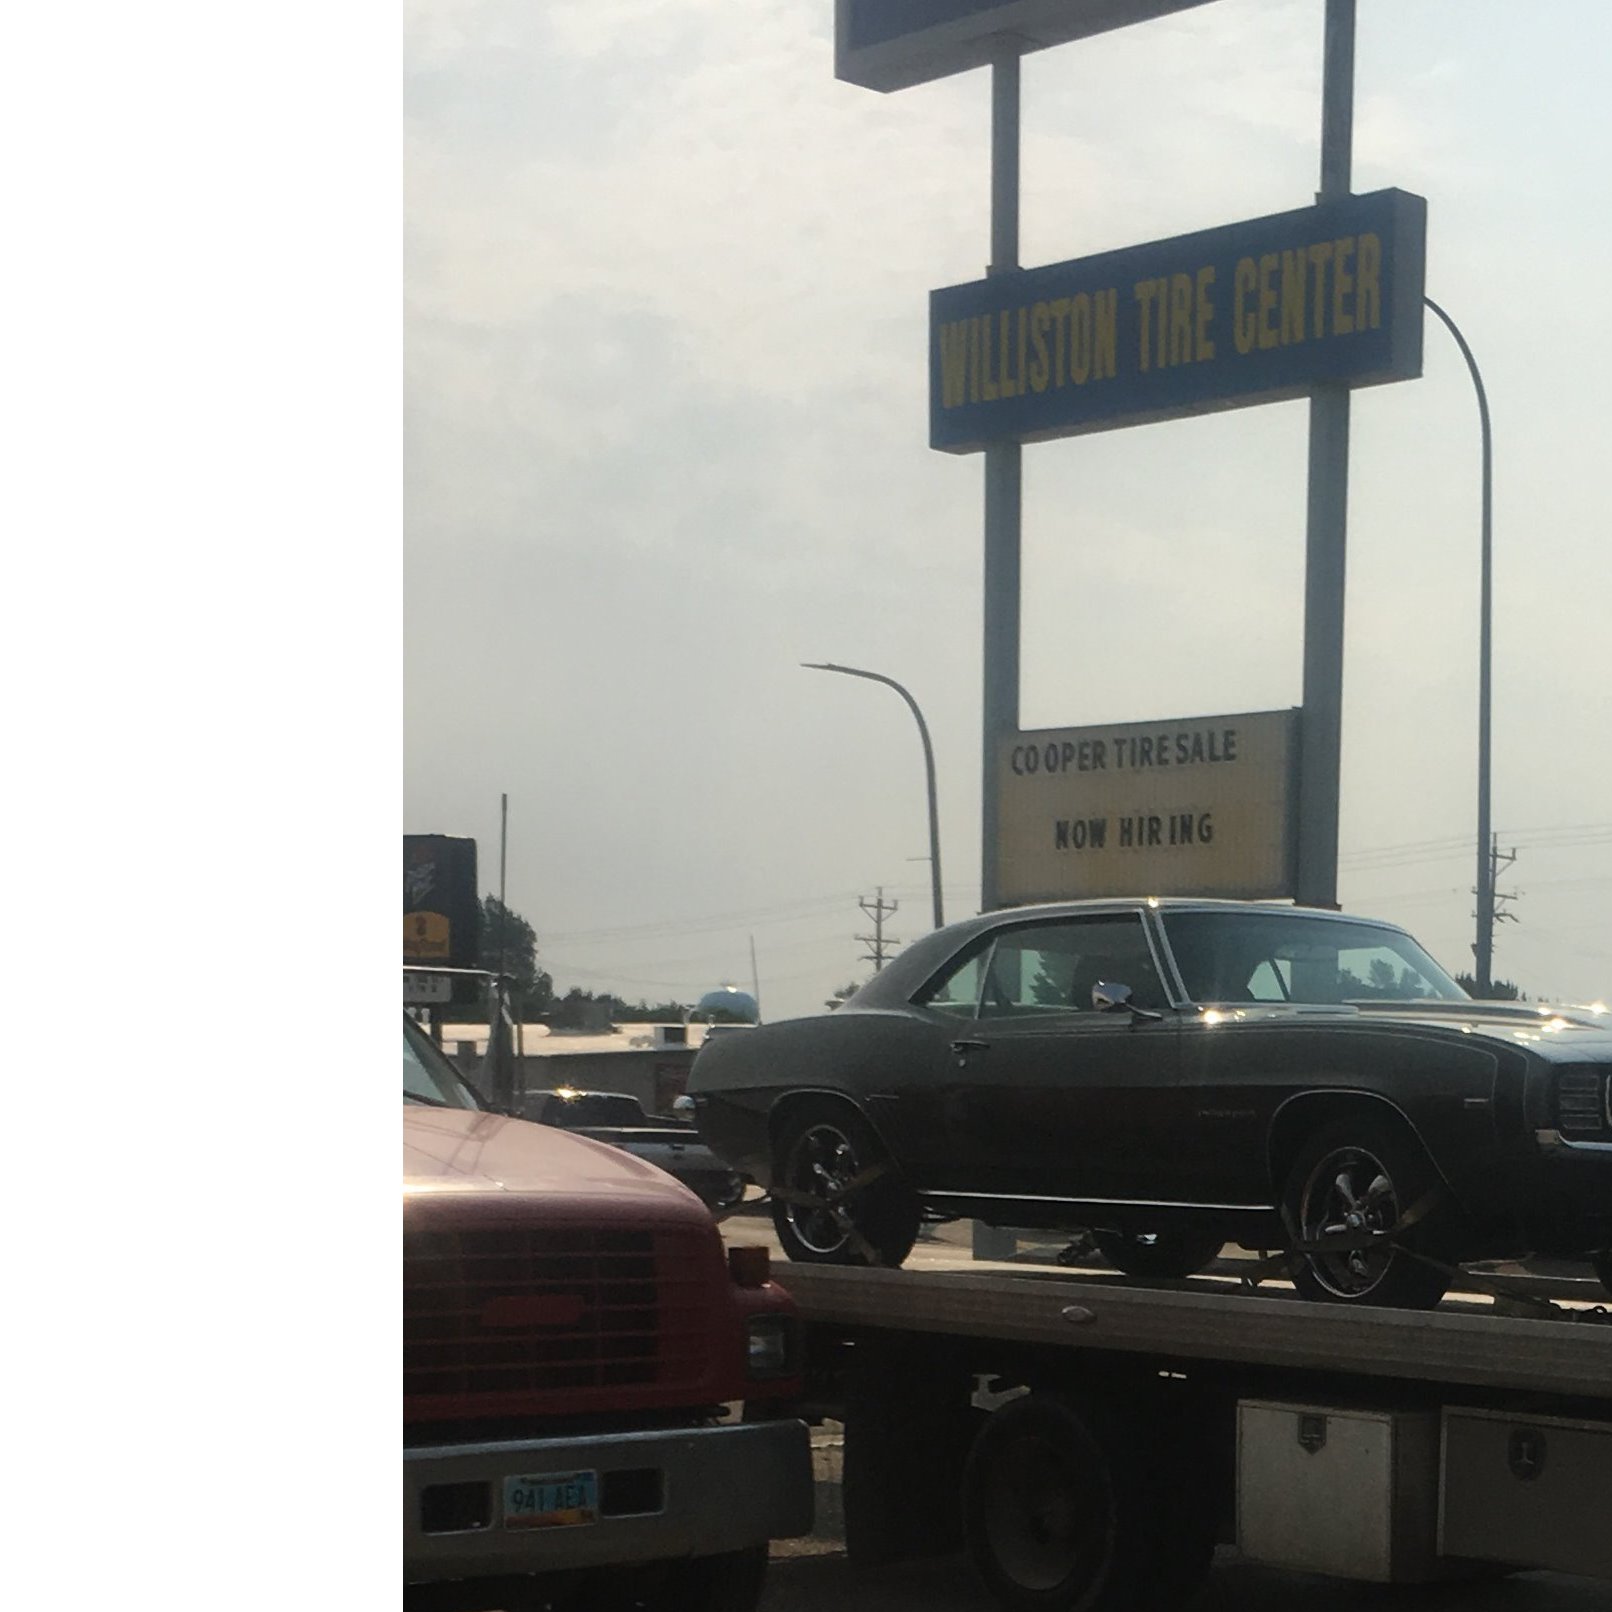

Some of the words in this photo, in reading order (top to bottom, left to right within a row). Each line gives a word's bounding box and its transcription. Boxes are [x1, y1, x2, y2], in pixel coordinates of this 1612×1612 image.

[939, 287, 1118, 409] WILLISTON
[1134, 265, 1215, 372] TIRE
[1233, 232, 1382, 355] CENTER
[1011, 738, 1107, 776] COOPER
[1114, 734, 1170, 769] TIRE
[1175, 729, 1238, 765] SALE
[1055, 817, 1108, 850] NOW
[1119, 813, 1214, 847] HIRING
